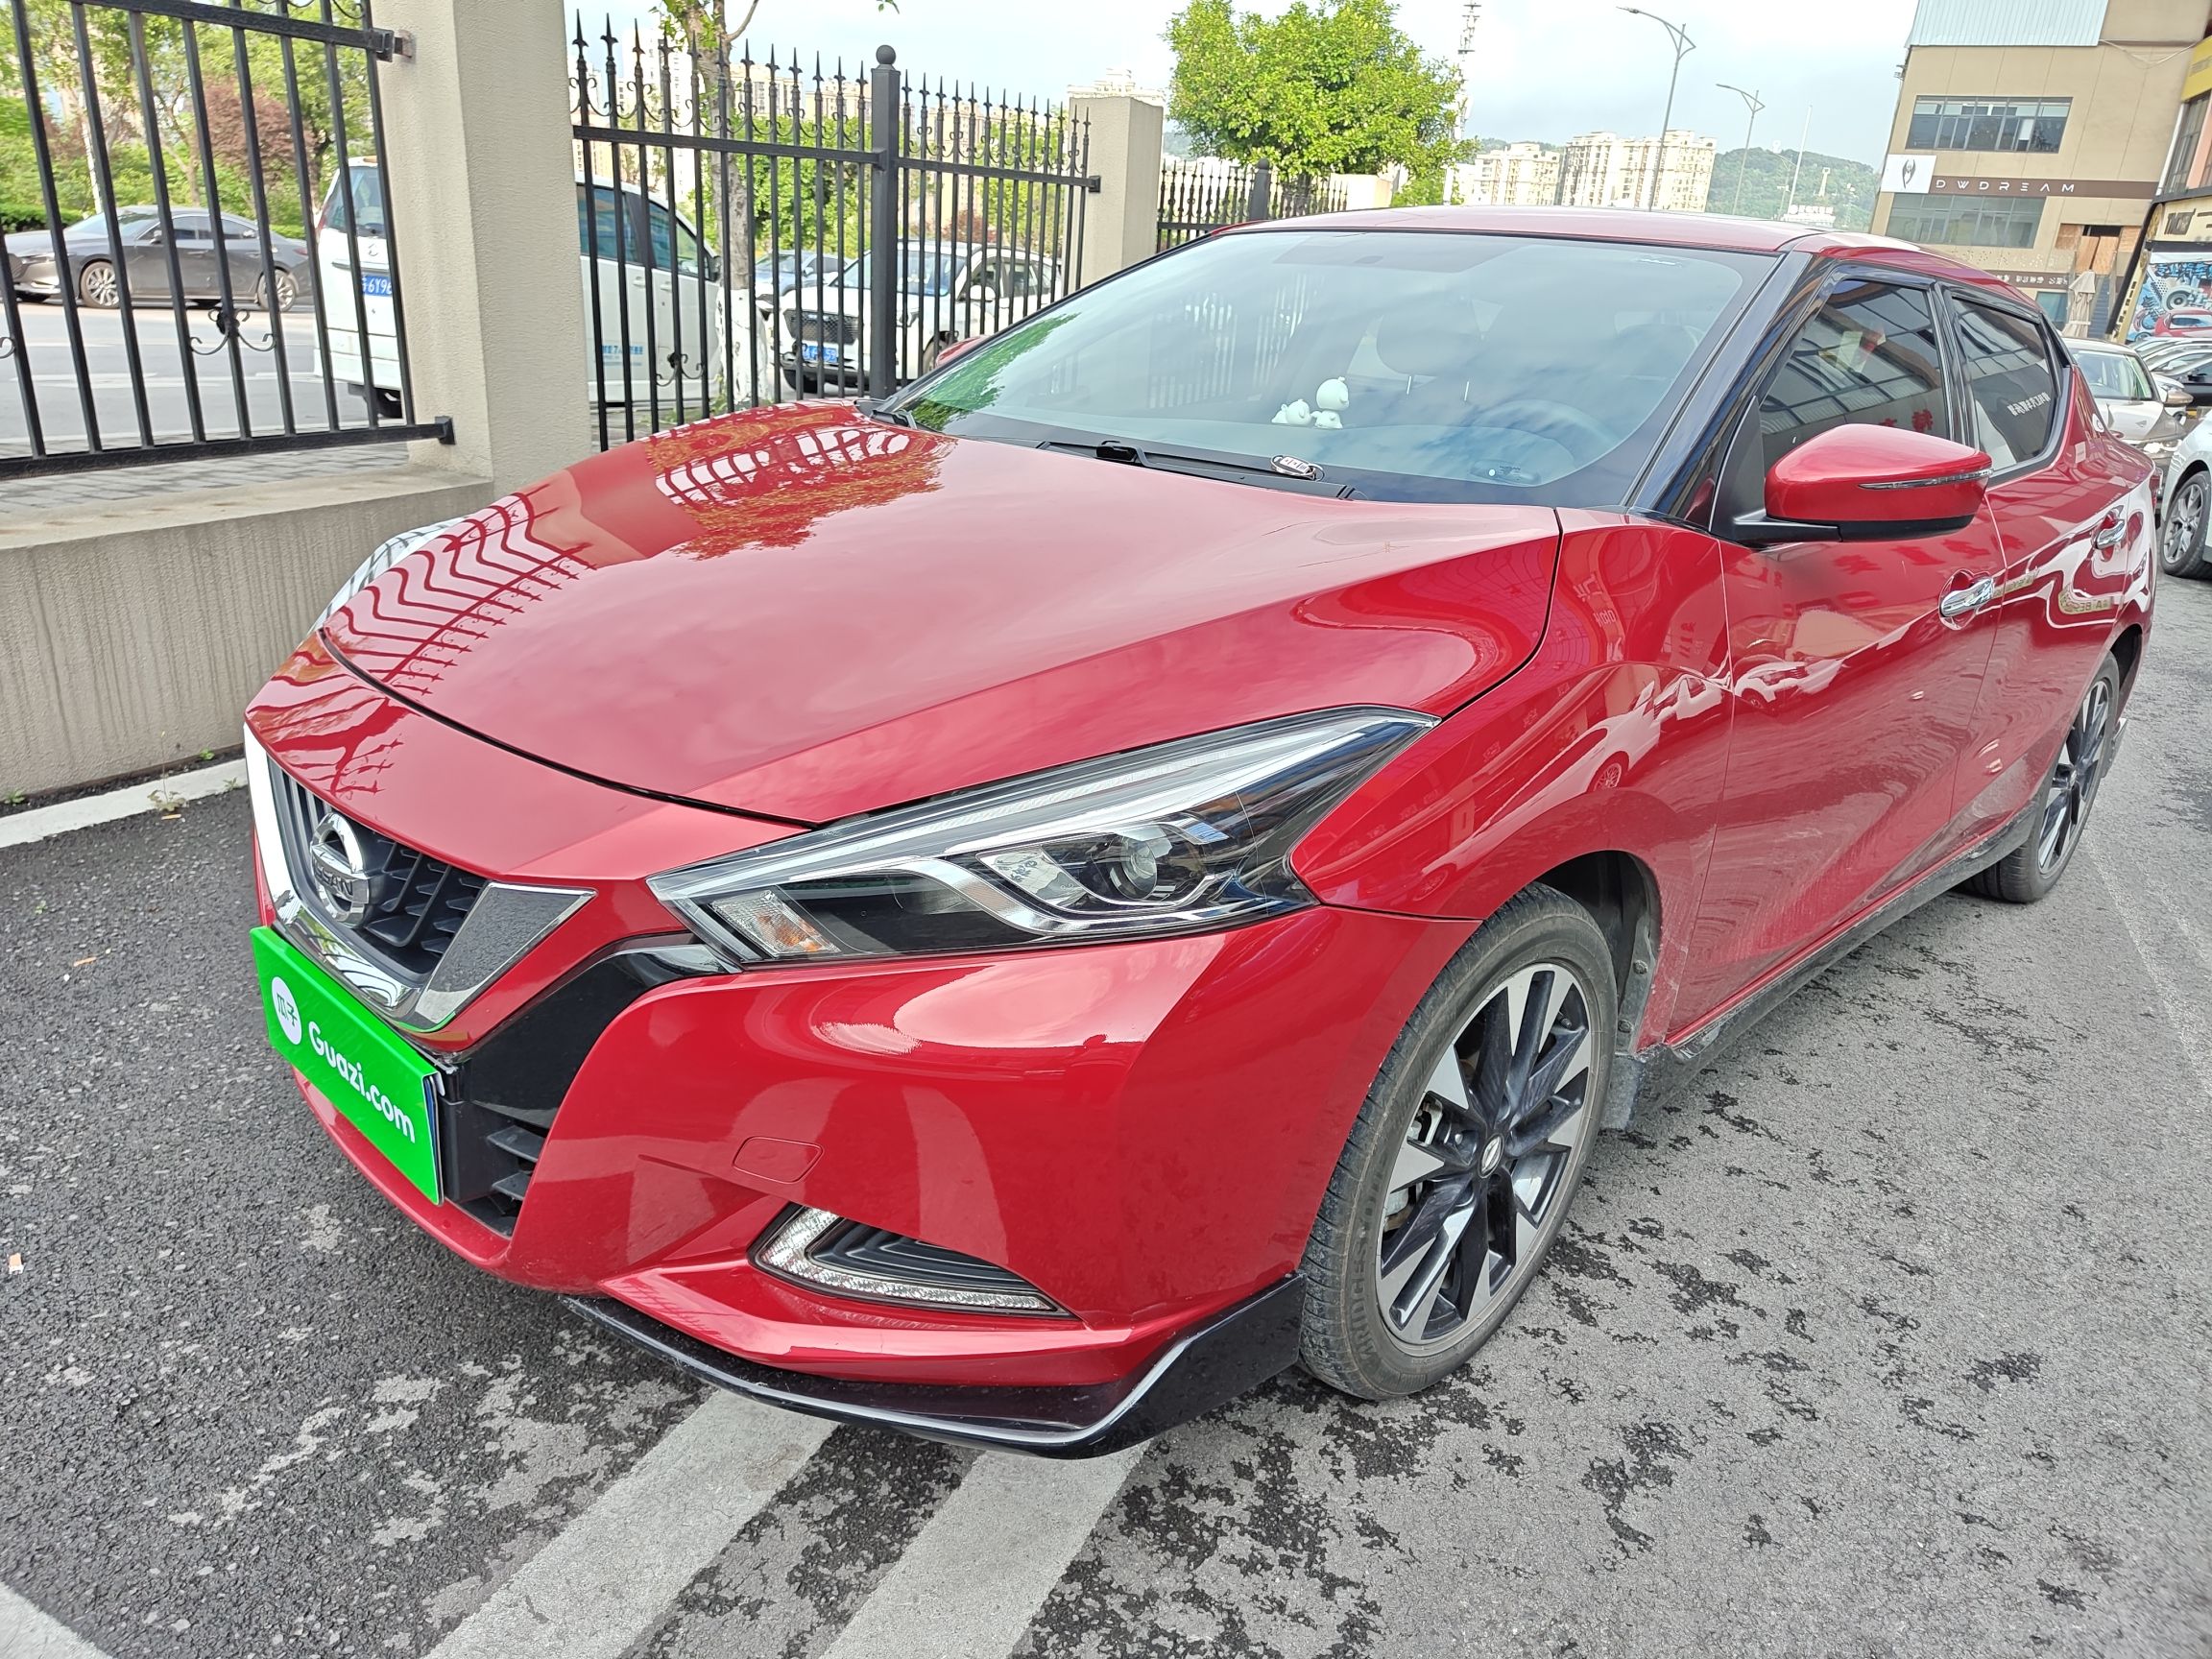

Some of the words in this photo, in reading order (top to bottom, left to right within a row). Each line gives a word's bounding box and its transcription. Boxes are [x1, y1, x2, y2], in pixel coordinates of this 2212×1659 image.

[2156, 262, 2212, 279] 专业汽车
[308, 1021, 416, 1143] Guazi.com
